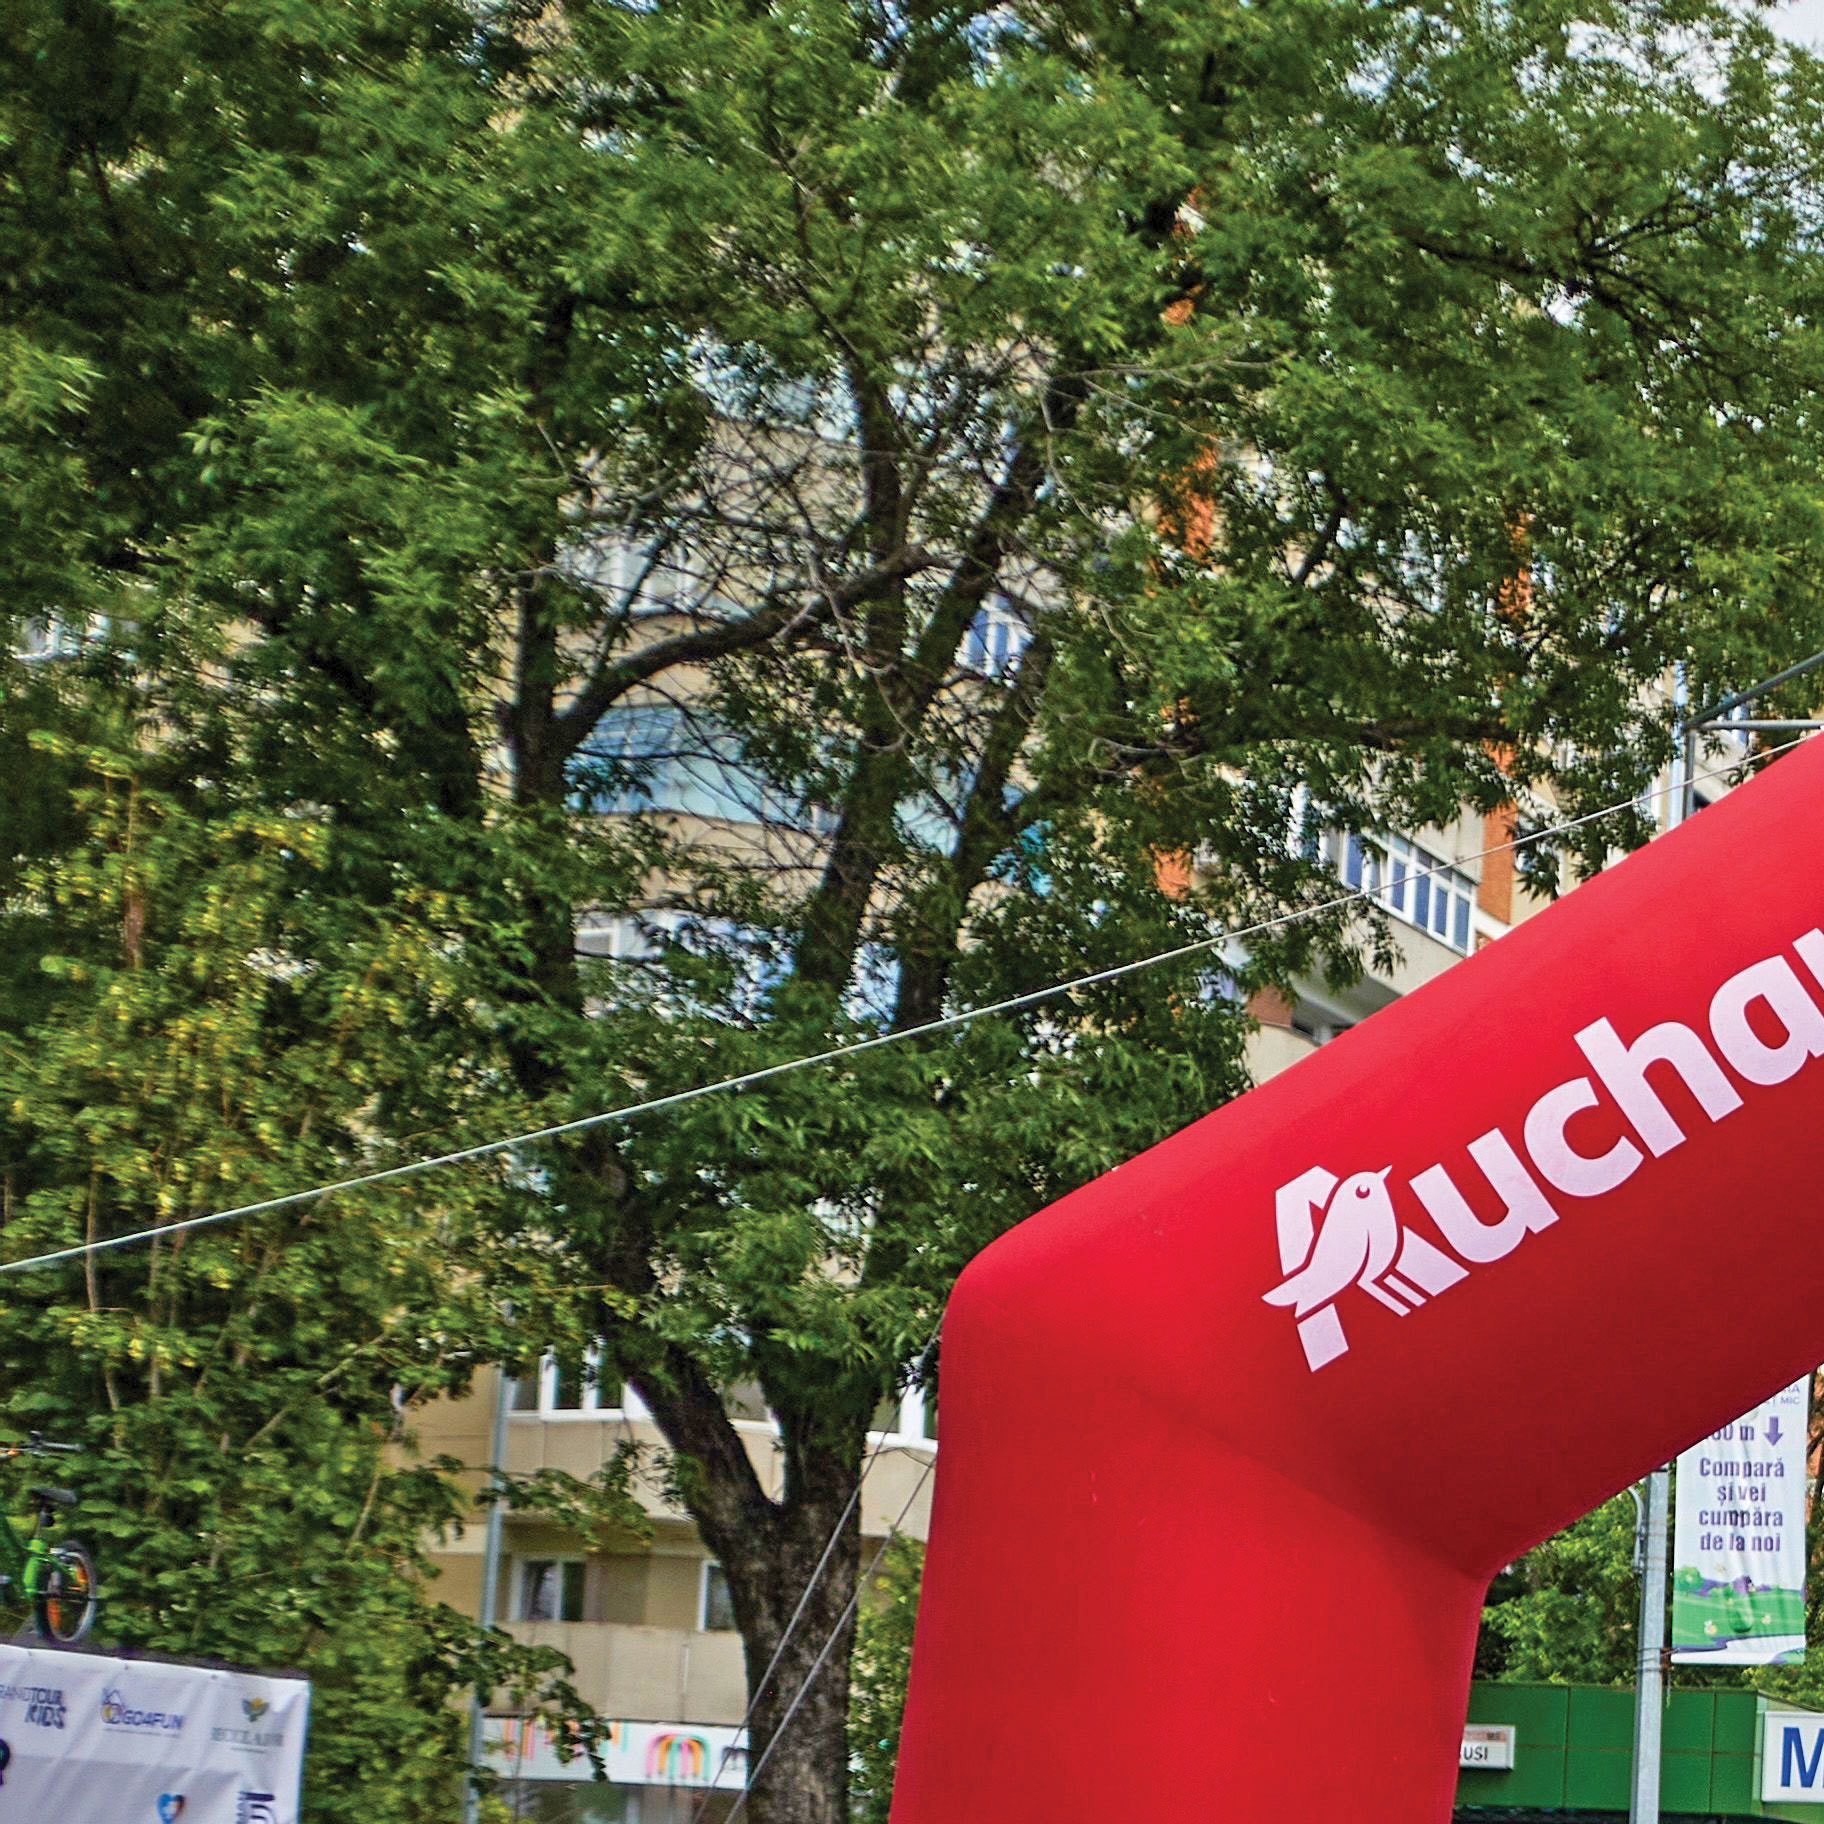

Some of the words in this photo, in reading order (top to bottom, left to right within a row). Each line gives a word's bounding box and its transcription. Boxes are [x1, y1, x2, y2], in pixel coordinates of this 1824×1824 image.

[1700, 1457, 1784, 1478] Compară
[1738, 1483, 1766, 1502] vei
[1699, 1507, 1783, 1528] cumpăra
[1700, 1532, 1723, 1551] de
[1730, 1533, 1745, 1552] la
[1752, 1535, 1781, 1552] noi
